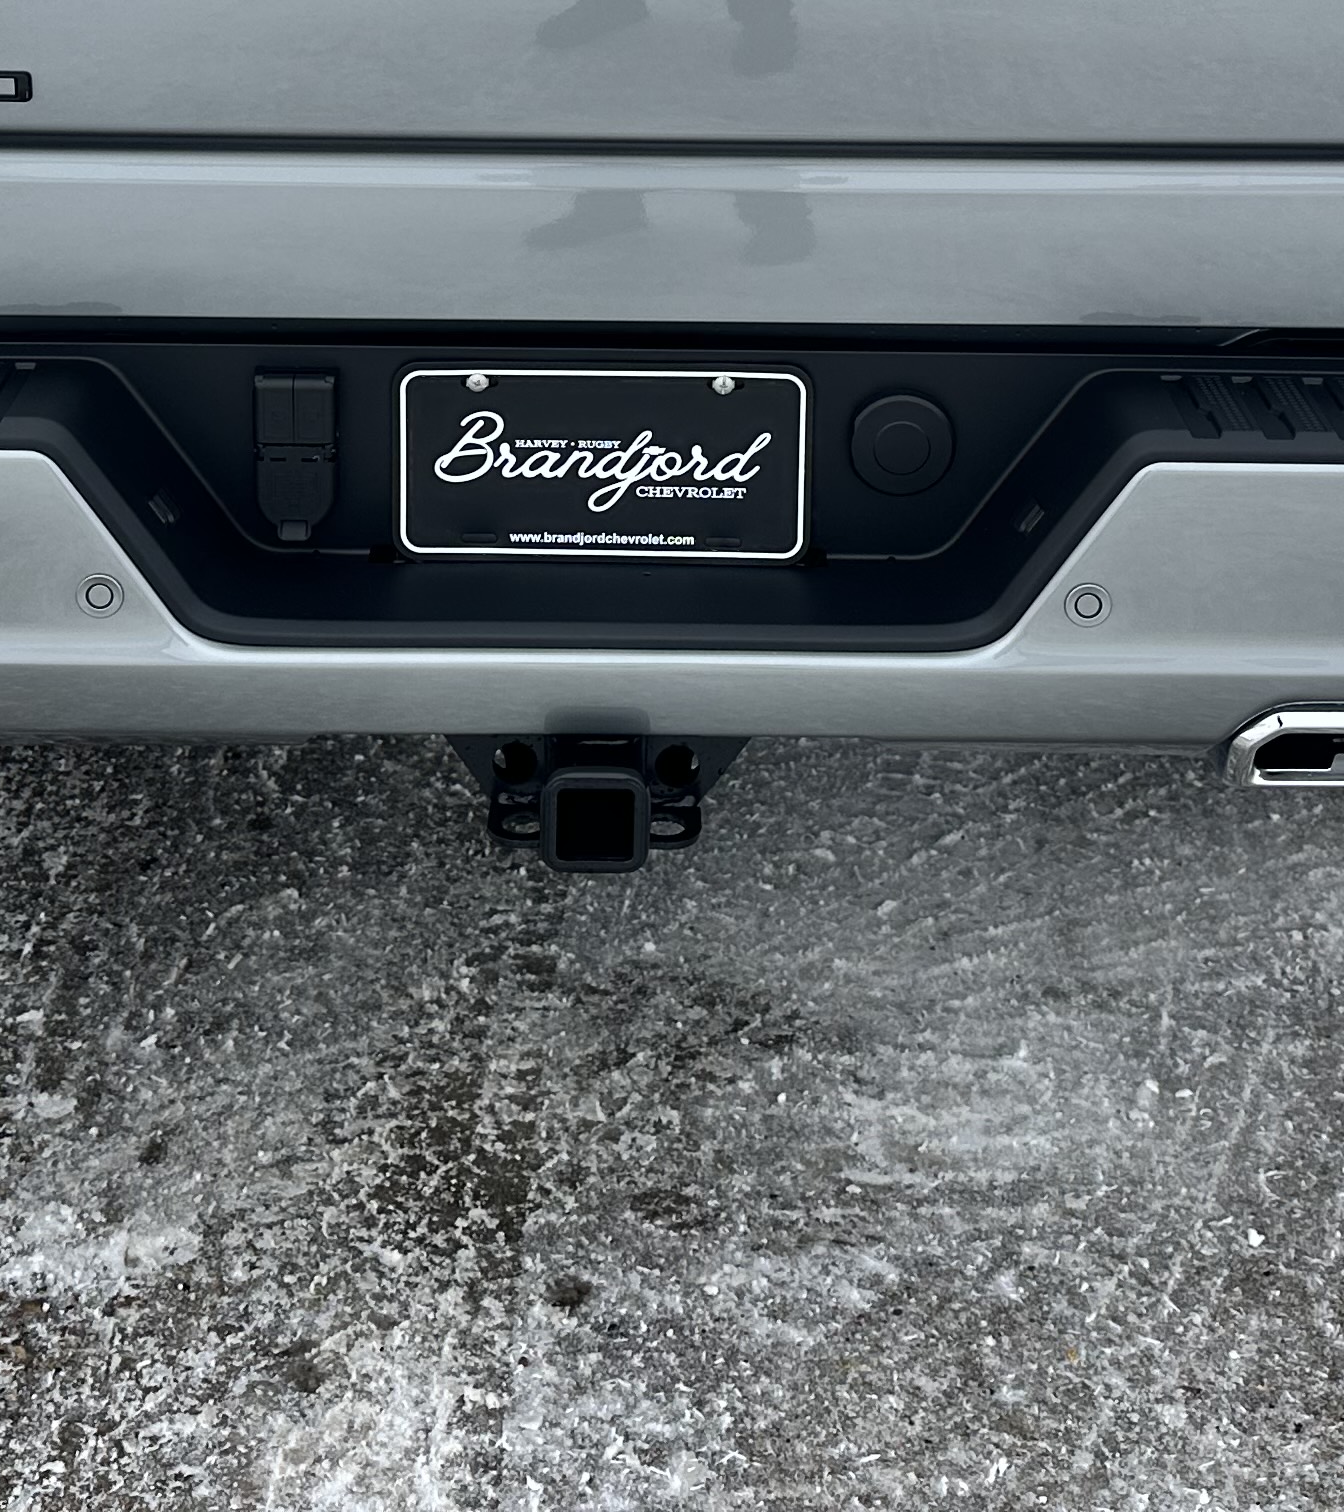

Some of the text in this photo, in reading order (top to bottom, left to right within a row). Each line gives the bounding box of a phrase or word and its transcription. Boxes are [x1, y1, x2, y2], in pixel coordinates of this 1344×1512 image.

[514, 439, 622, 450] HARVEY RUGBY
[434, 410, 772, 513] Brandjord
[635, 486, 747, 500] CHEVROLET
[509, 531, 695, 547] www.brandjordchevrolet.com
